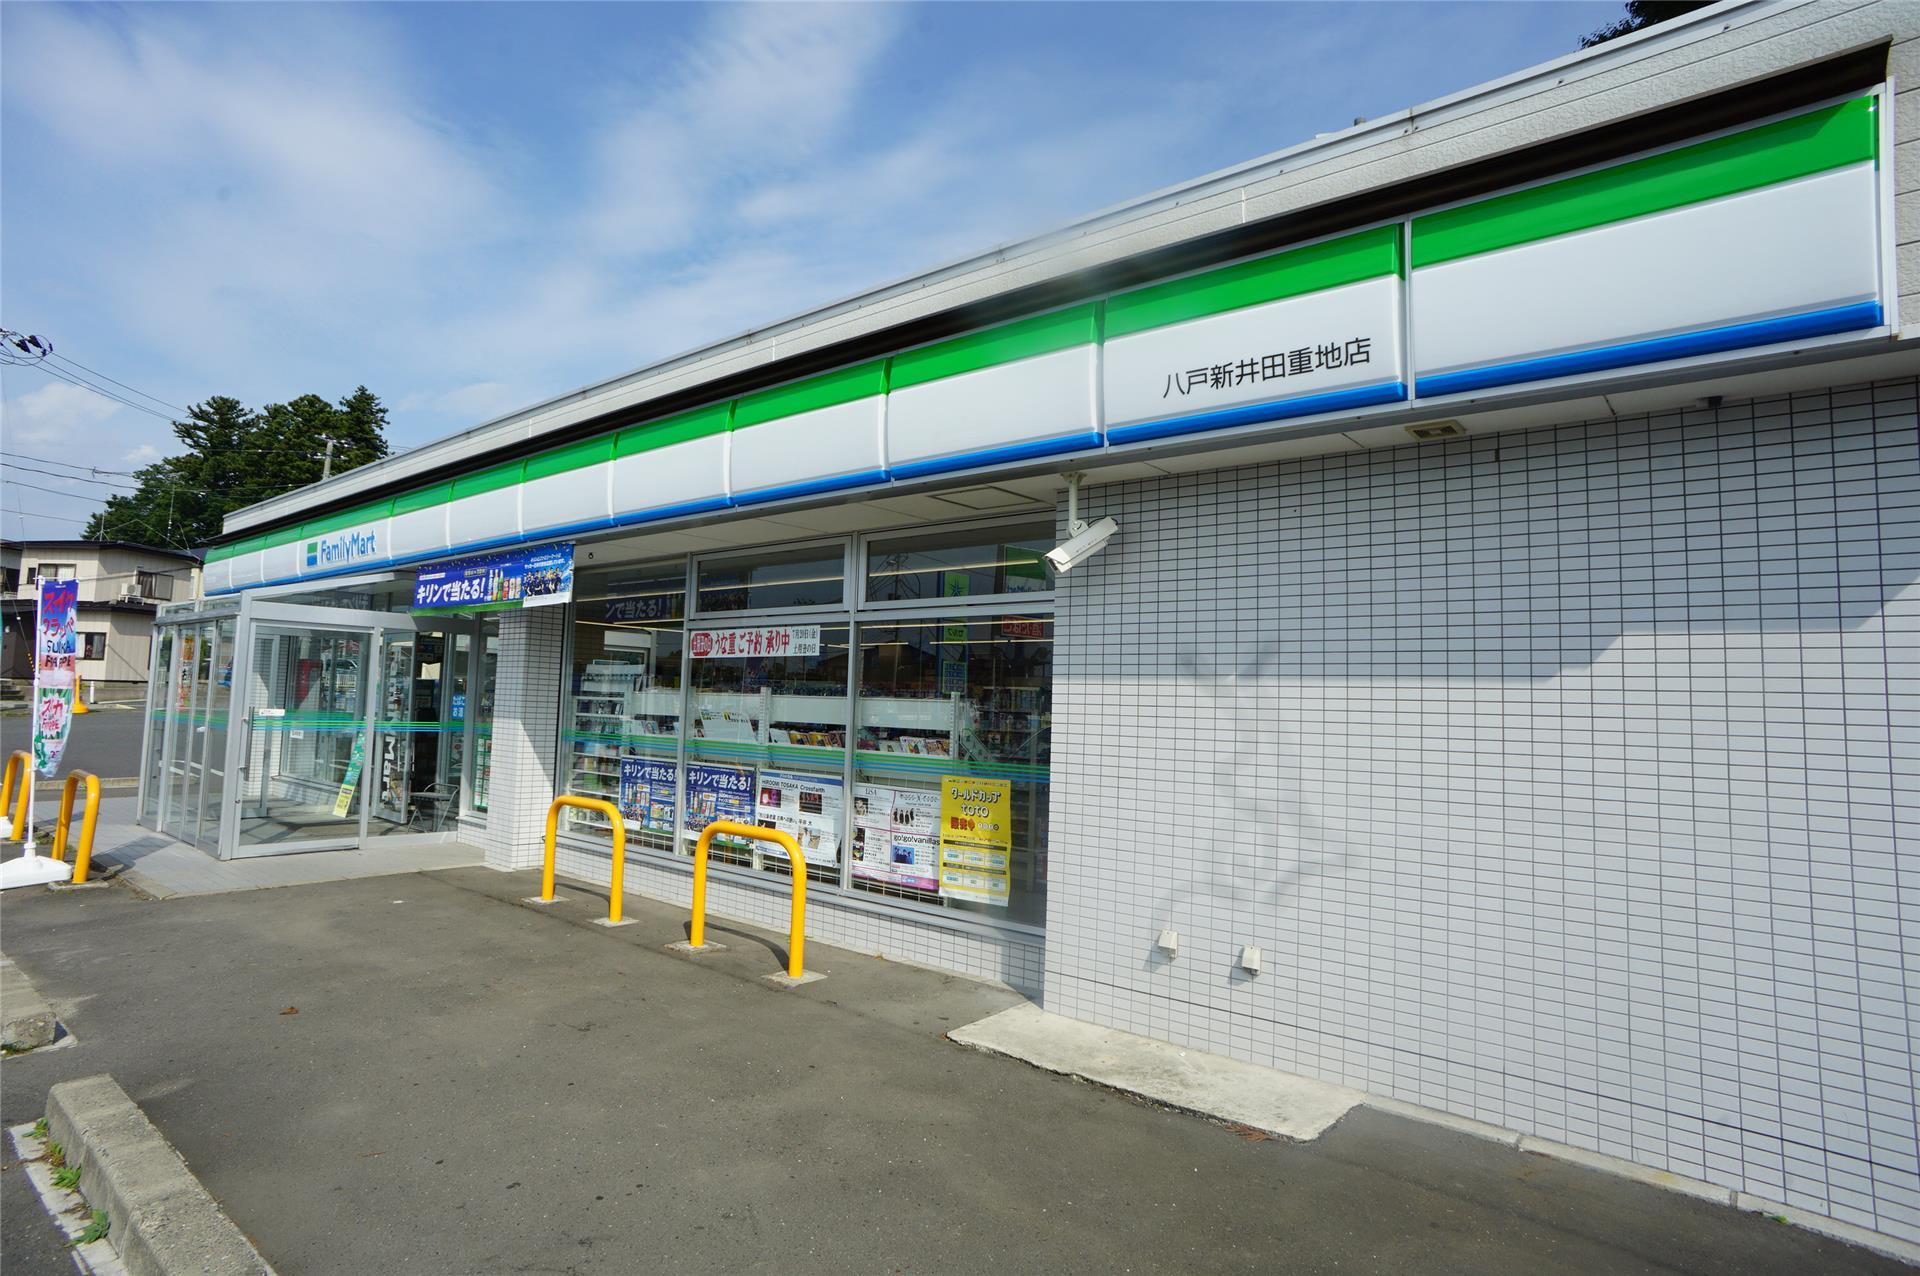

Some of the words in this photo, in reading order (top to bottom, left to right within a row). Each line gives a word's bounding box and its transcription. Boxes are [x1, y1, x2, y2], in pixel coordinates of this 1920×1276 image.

[1162, 337, 1371, 398] 八戸新井田重地店
[320, 530, 375, 563] FamilyMart
[688, 770, 751, 791] キリンで当たる!
